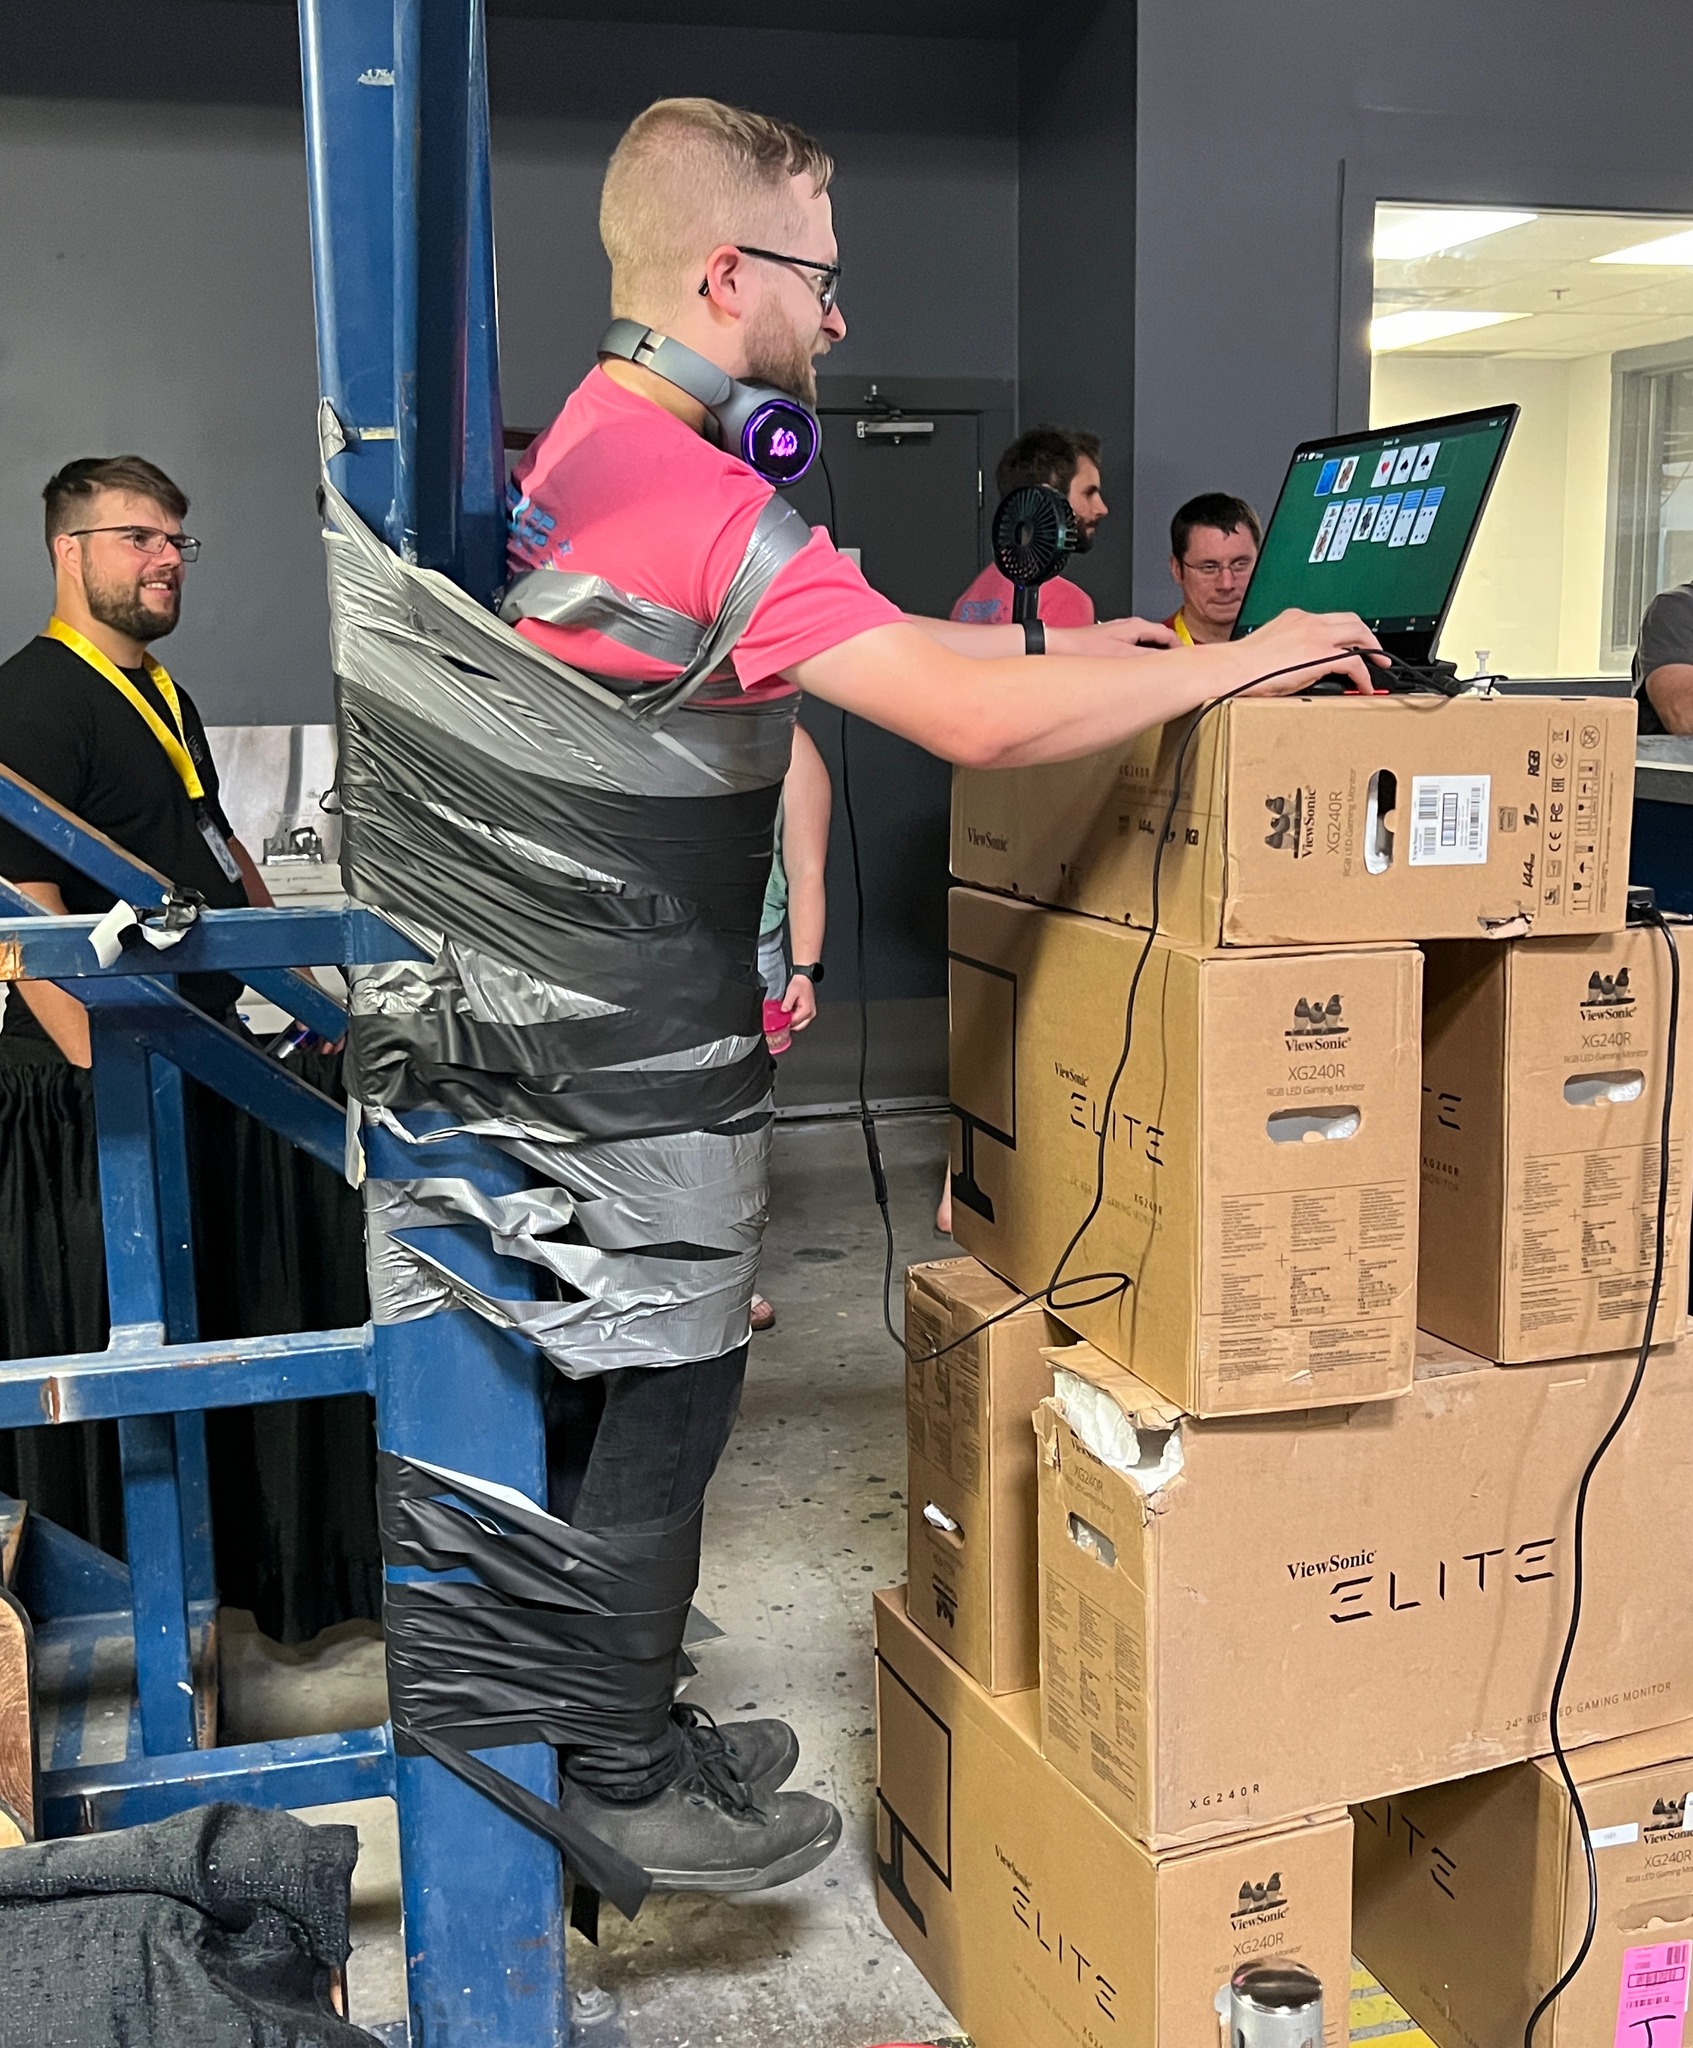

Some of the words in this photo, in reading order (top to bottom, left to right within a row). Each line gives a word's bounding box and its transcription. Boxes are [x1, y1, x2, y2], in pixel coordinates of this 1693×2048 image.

[1528, 750, 1541, 776] RGB
[1301, 787, 1317, 859] ViewSonic
[1326, 790, 1343, 855] XG240R
[967, 826, 1009, 852] ViewSonic
[1580, 1008, 1635, 1021] ViewSonic
[1285, 1037, 1350, 1052] ViewSonic
[1581, 1031, 1632, 1049] XG240R
[1563, 1054, 1580, 1064] RGB
[1580, 1053, 1595, 1063] LED
[1595, 1051, 1622, 1063] Gaming
[1288, 1063, 1345, 1081] XG240R
[1266, 1087, 1285, 1097] RGB
[1286, 1086, 1302, 1096] LED
[1303, 1084, 1334, 1096] Gaming
[1335, 1083, 1365, 1092] Monitor
[1070, 1091, 1165, 1166] ELITE
[1287, 1550, 1376, 1580] ViewSonic
[1329, 1537, 1557, 1623] ELITE
[1527, 1711, 1548, 1725] RGB
[1558, 1706, 1573, 1718] ED
[1576, 1694, 1619, 1713] GAMING
[1623, 1681, 1672, 1701] MONITOR
[1189, 1783, 1261, 1810] XG240R
[1360, 1802, 1457, 1900] LITE
[1644, 1849, 1692, 1869] XG240R
[1231, 1909, 1288, 1932] ViewSonic
[1012, 1885, 1117, 2023] ELITE
[1232, 1932, 1285, 1958] XG240R
[1214, 1963, 1231, 1975] RGB
